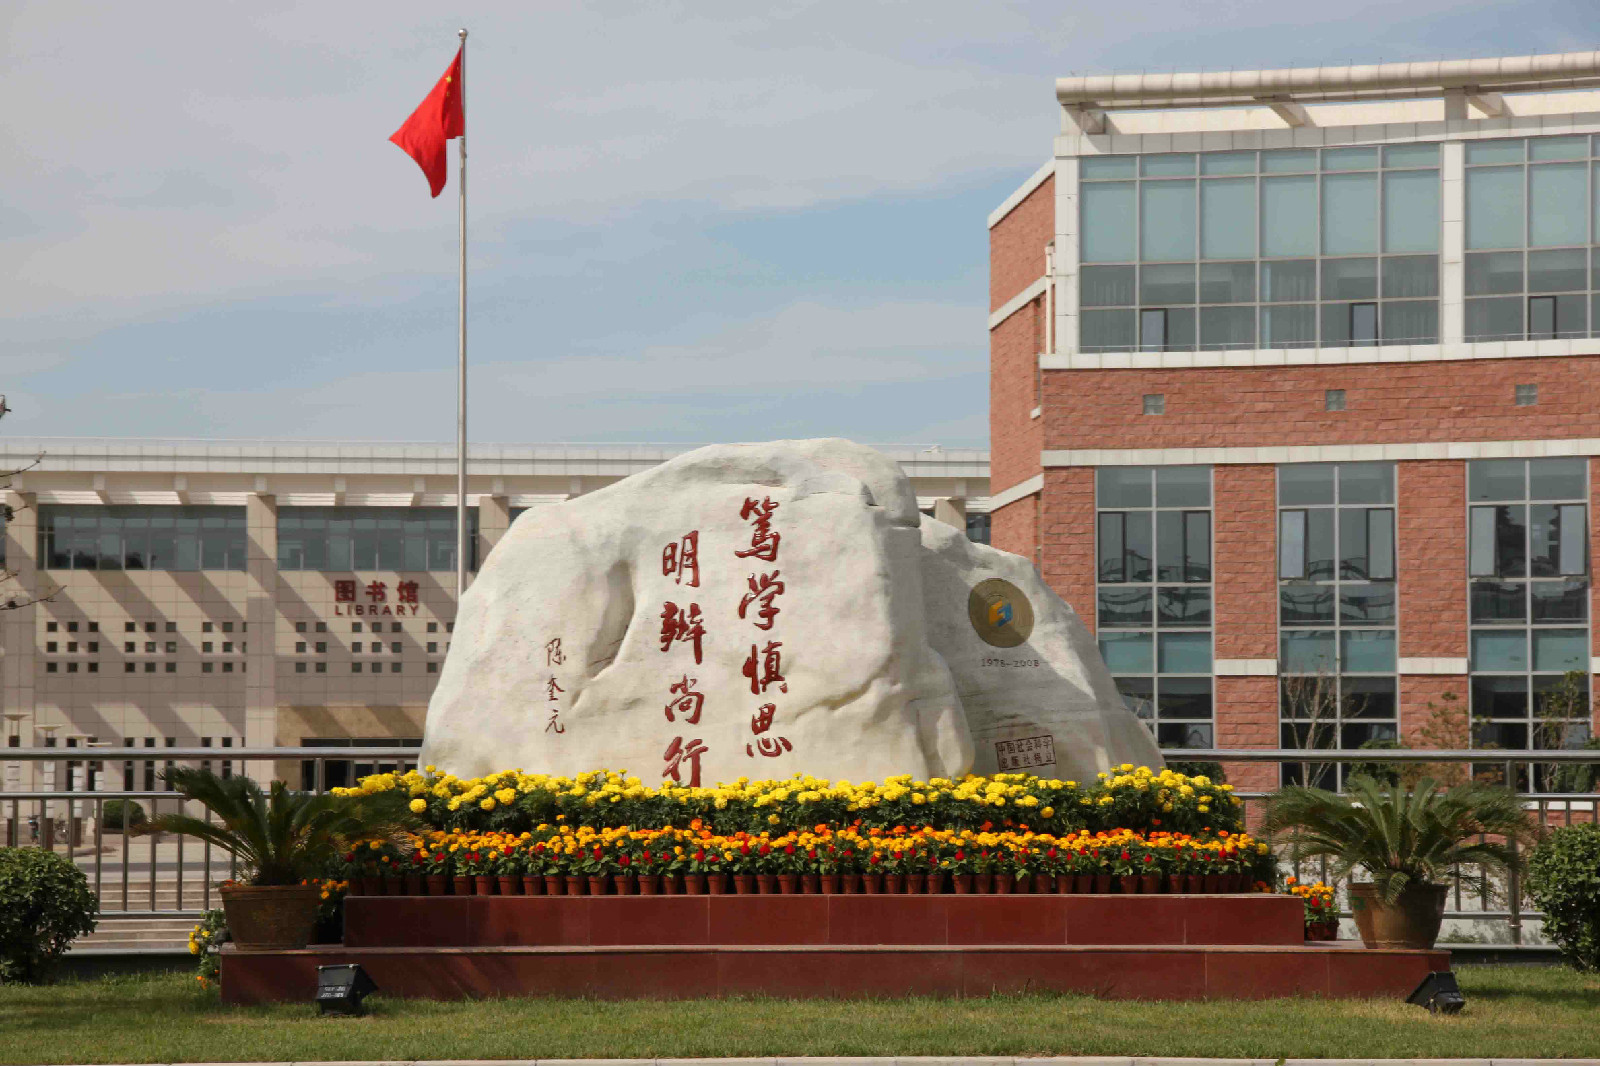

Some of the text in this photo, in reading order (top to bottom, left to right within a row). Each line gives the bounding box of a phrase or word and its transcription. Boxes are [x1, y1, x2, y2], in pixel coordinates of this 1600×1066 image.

[335, 580, 419, 603] 图书馆
[335, 604, 419, 616] LIBRARY
[981, 658, 1040, 668] 1978-2008
